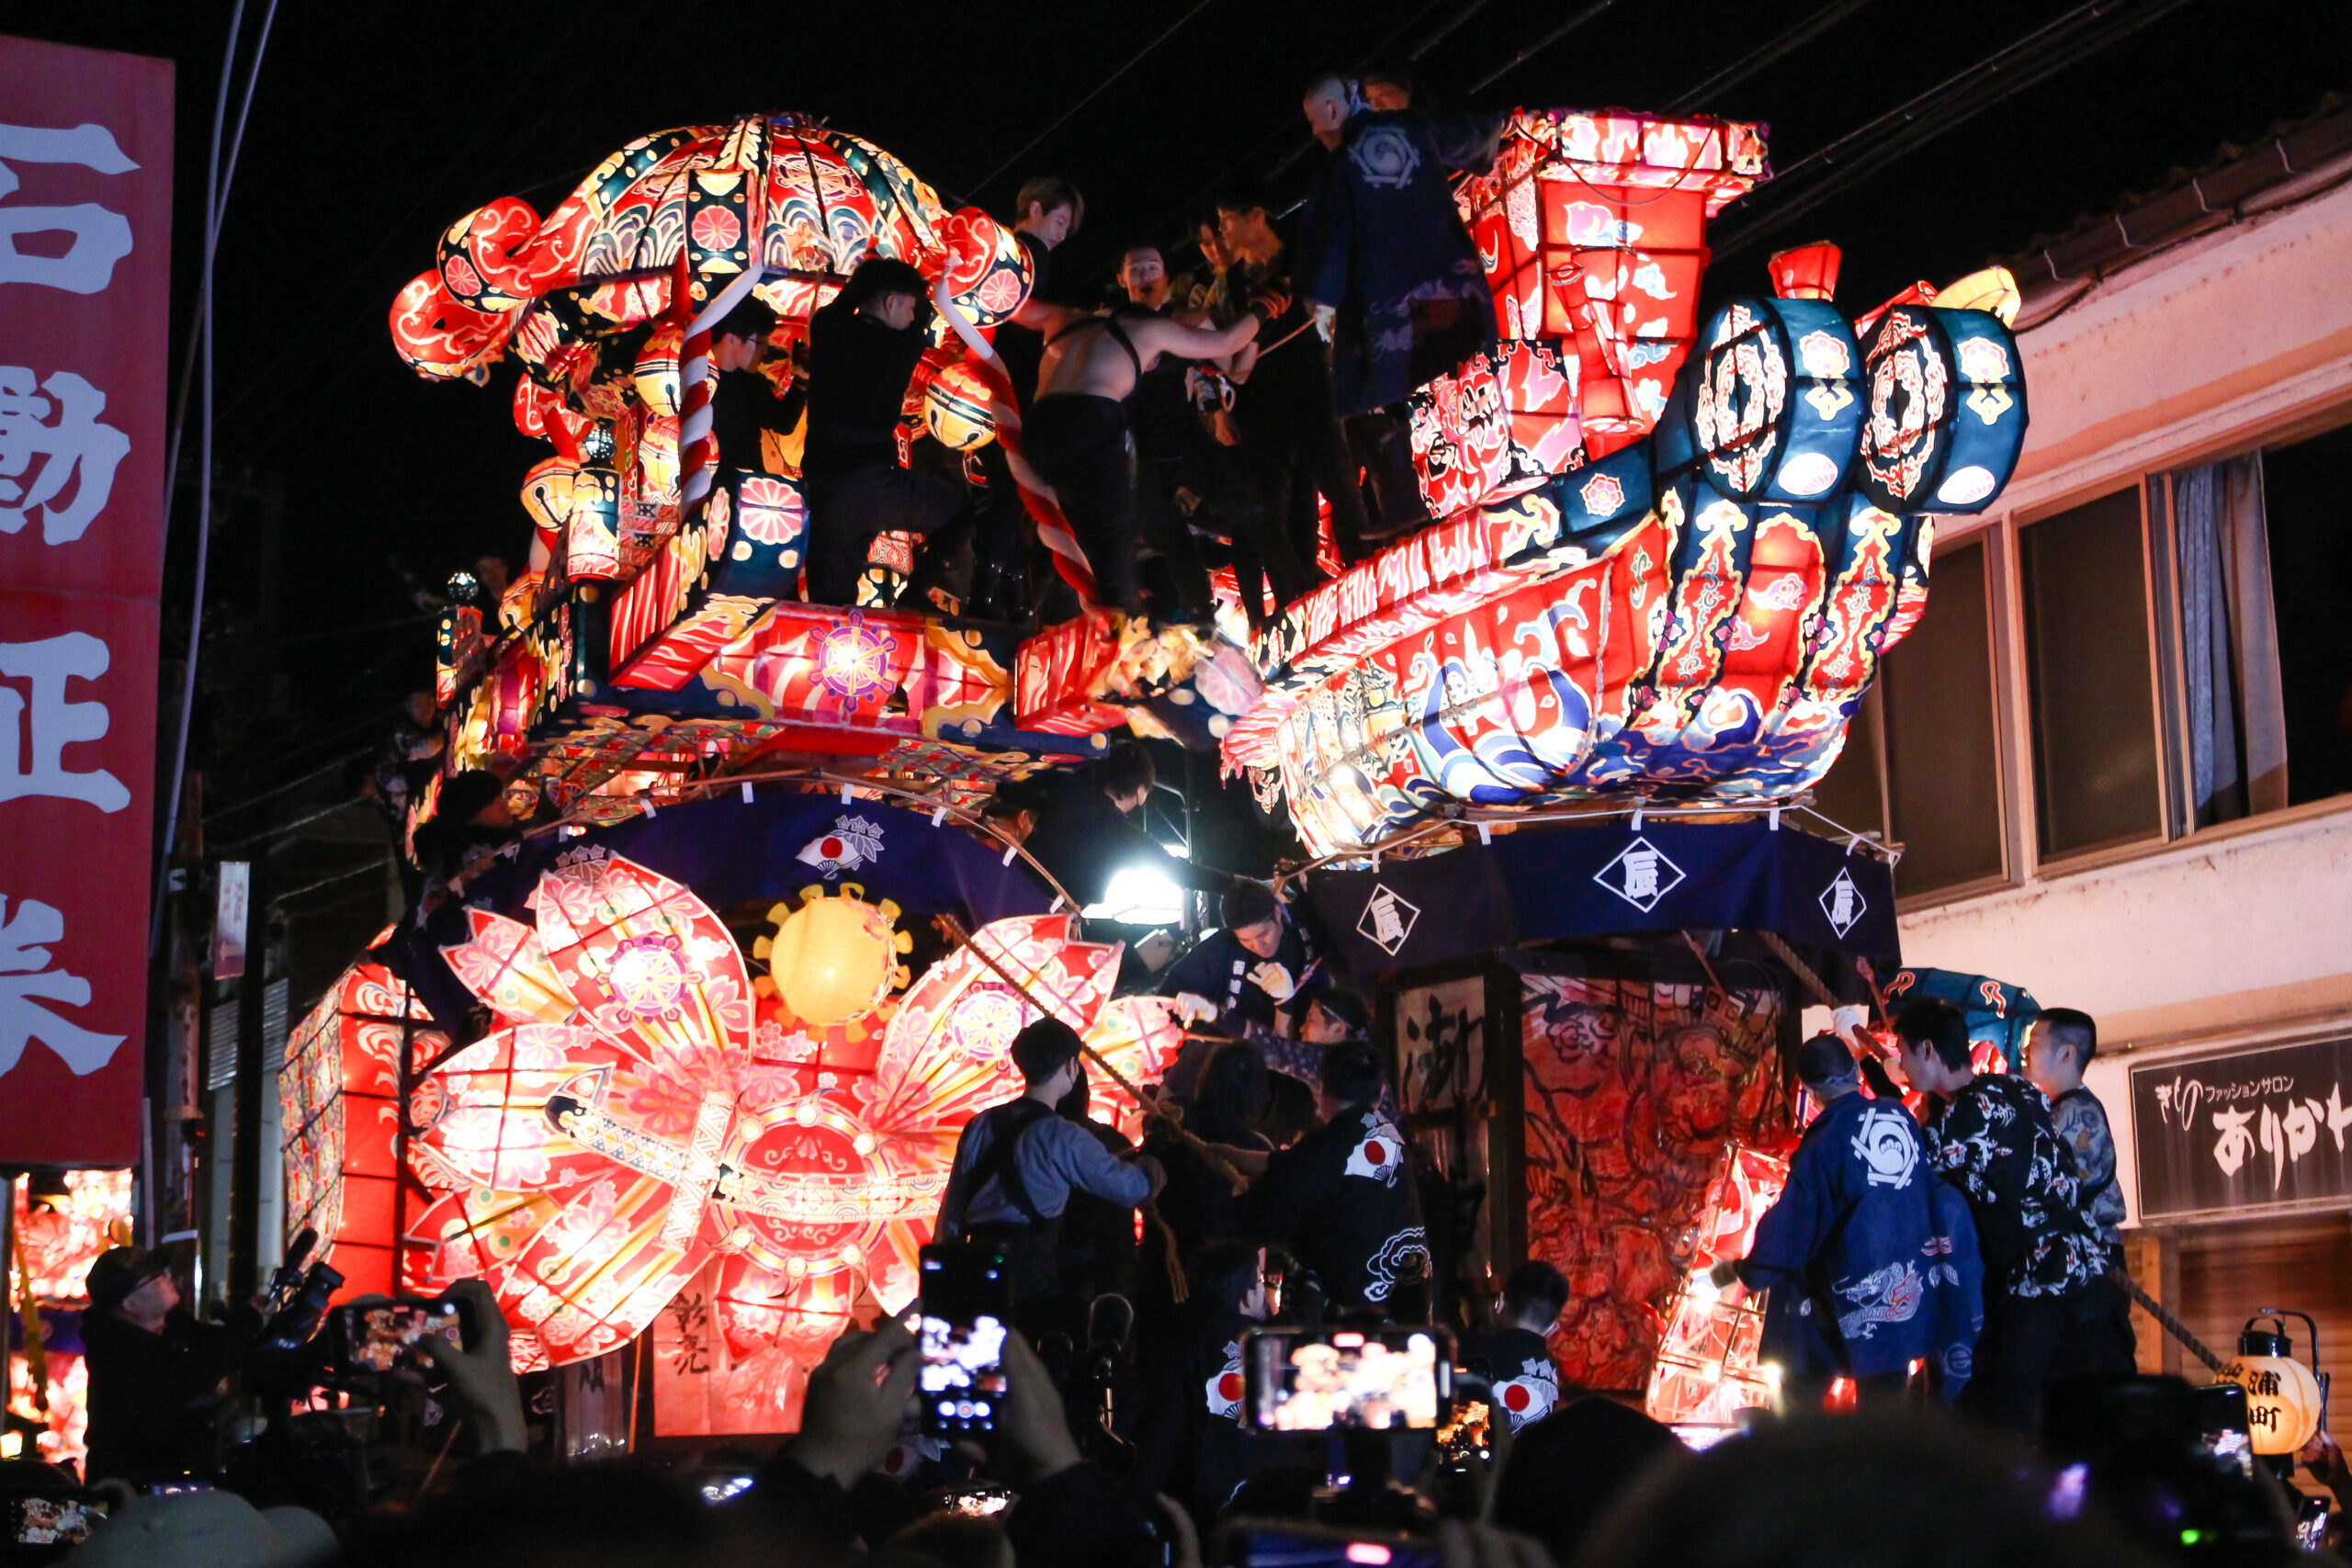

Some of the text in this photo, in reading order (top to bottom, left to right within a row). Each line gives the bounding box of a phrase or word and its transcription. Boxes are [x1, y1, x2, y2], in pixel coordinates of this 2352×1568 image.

[2205, 1076, 2294, 1103] ファッションサロン
